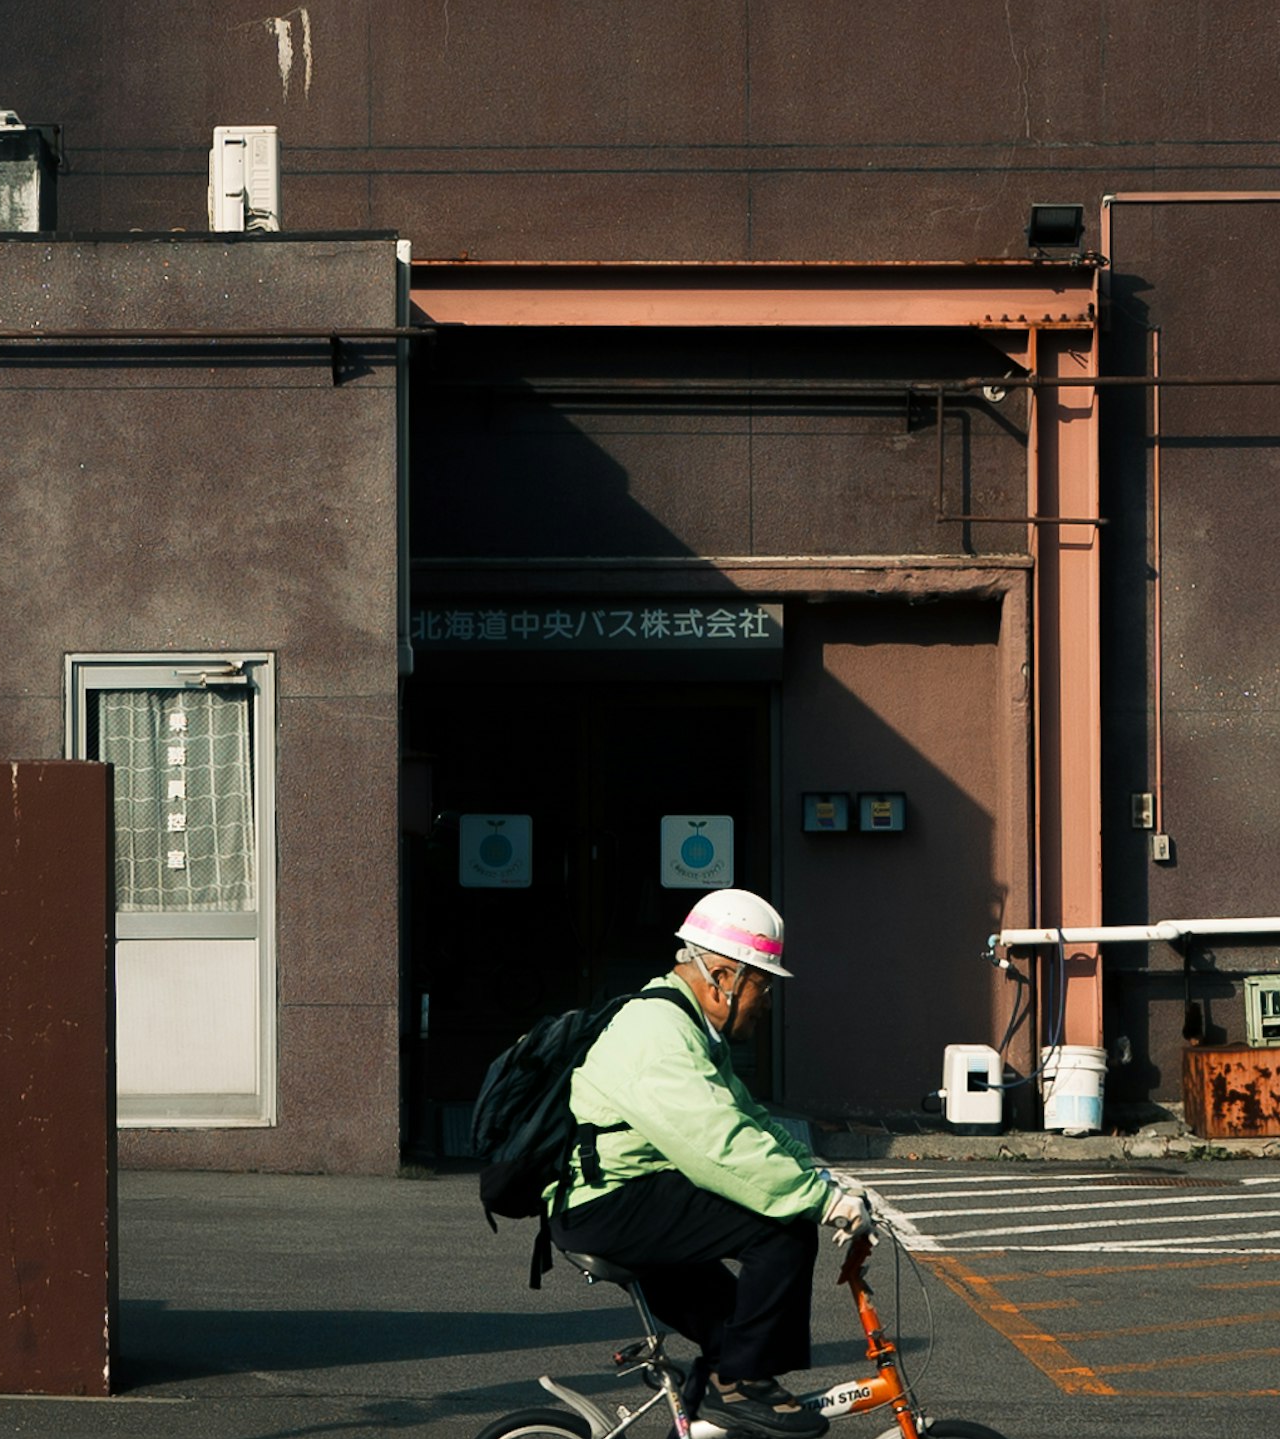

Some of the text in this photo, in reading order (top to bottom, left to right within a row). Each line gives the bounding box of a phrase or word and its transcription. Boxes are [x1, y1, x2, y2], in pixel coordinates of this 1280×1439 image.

[412, 609, 770, 641] 北海道中央バス株式会社
[838, 1387, 871, 1404] STAG
